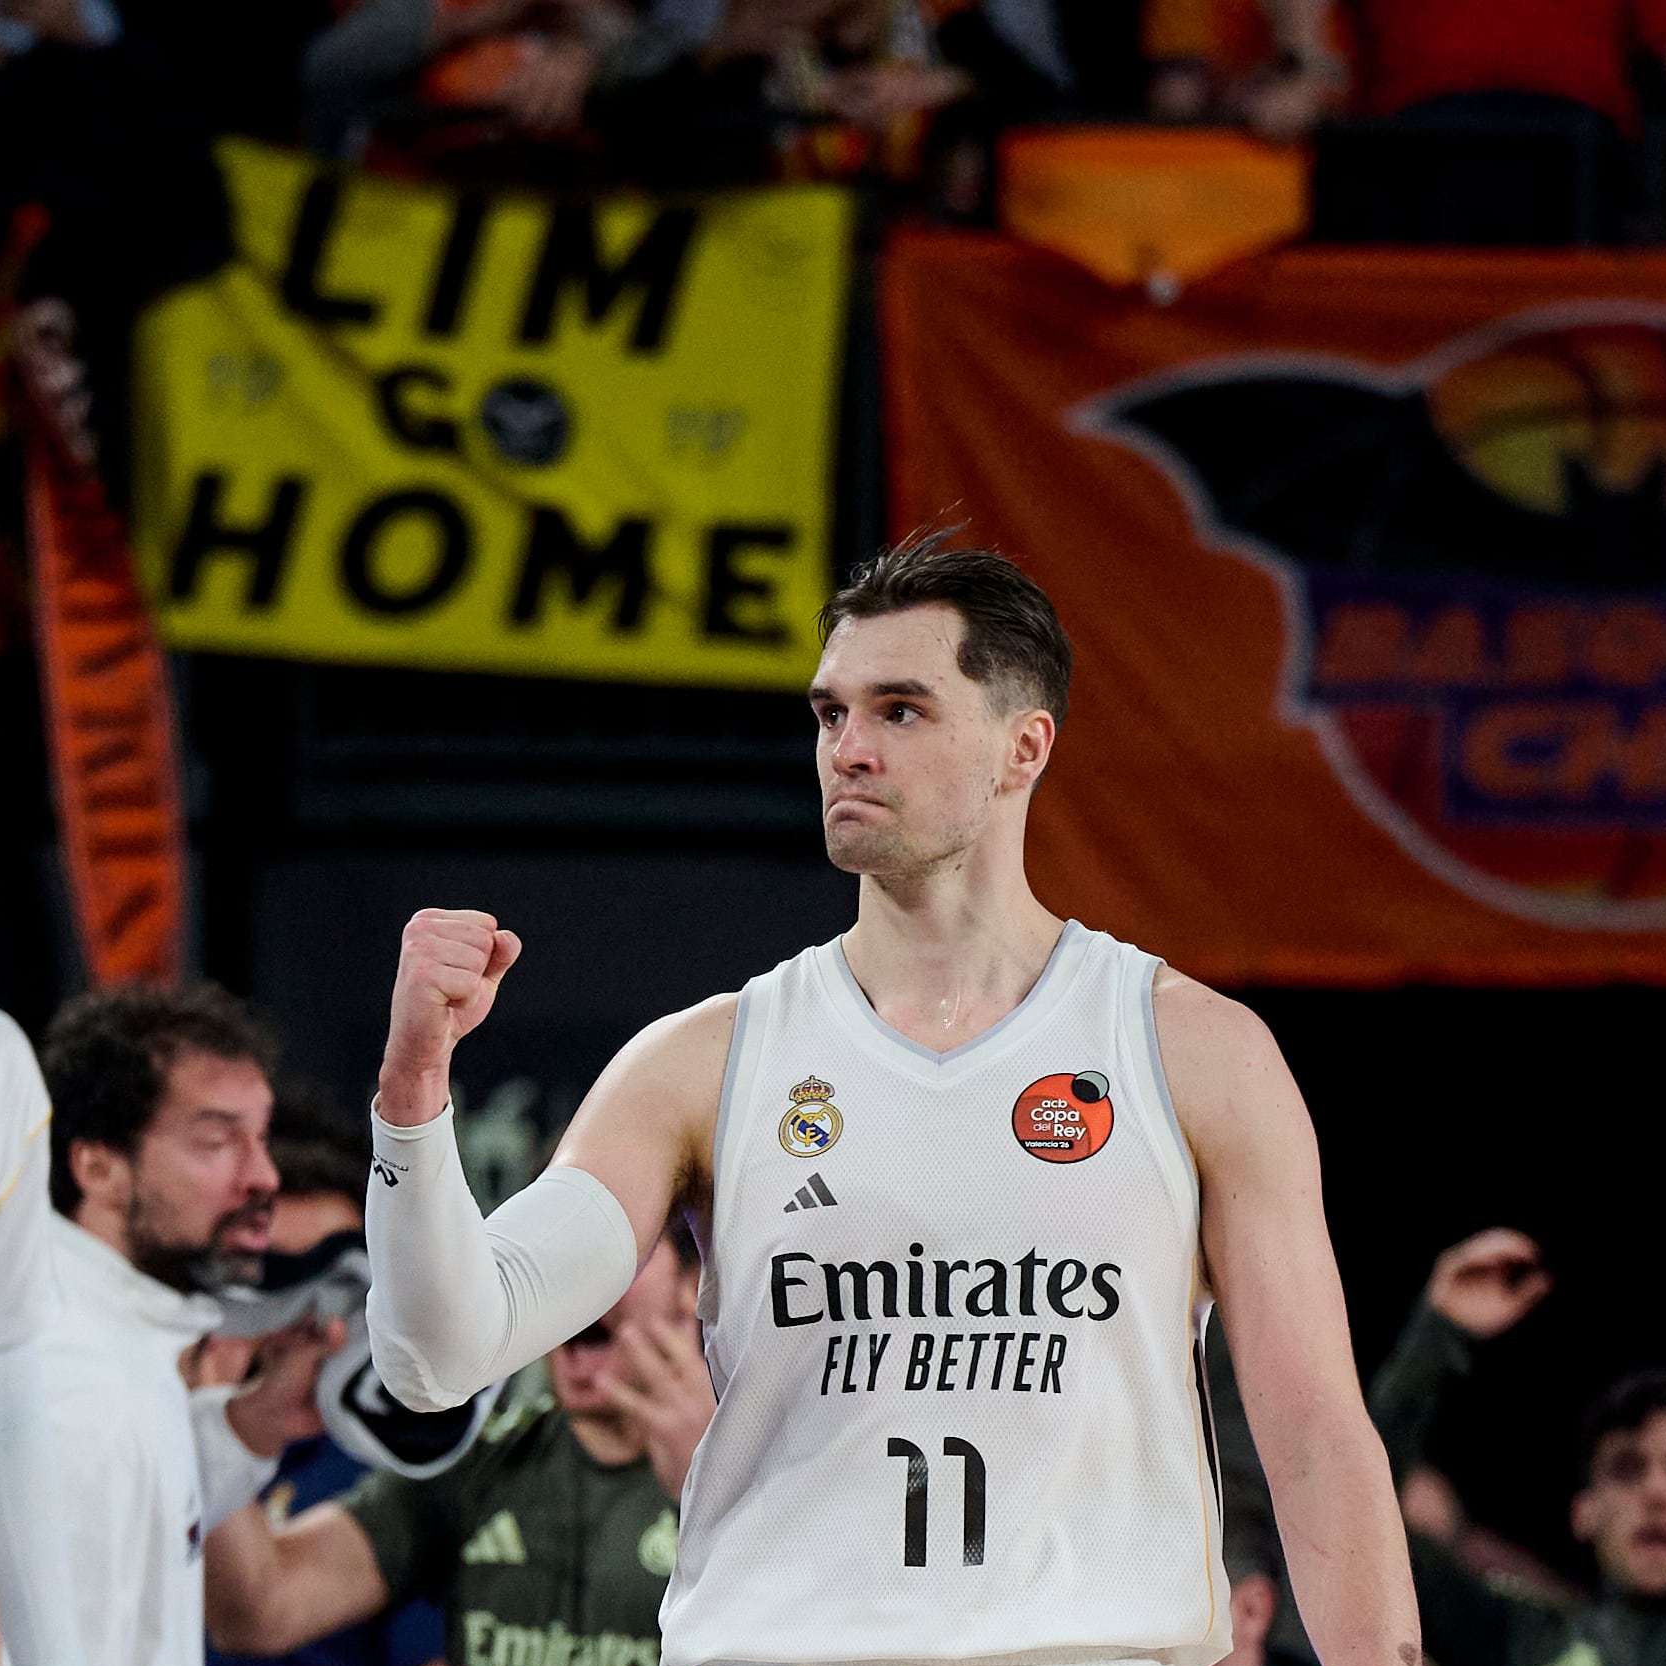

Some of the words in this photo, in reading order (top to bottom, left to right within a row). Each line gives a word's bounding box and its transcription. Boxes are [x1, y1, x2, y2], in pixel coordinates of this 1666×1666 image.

[283, 178, 702, 356] LIM
[170, 473, 799, 648] HOME
[1030, 1108, 1081, 1123] Copa
[1033, 1122, 1052, 1132] del
[1053, 1123, 1087, 1140] Rey
[1041, 1098, 1068, 1109] acb
[1025, 1140, 1059, 1148] Valencia
[771, 1243, 1121, 1327] Emirates
[821, 1333, 889, 1396] FLY
[905, 1332, 1067, 1394] BETTER
[887, 1437, 986, 1568] 11
